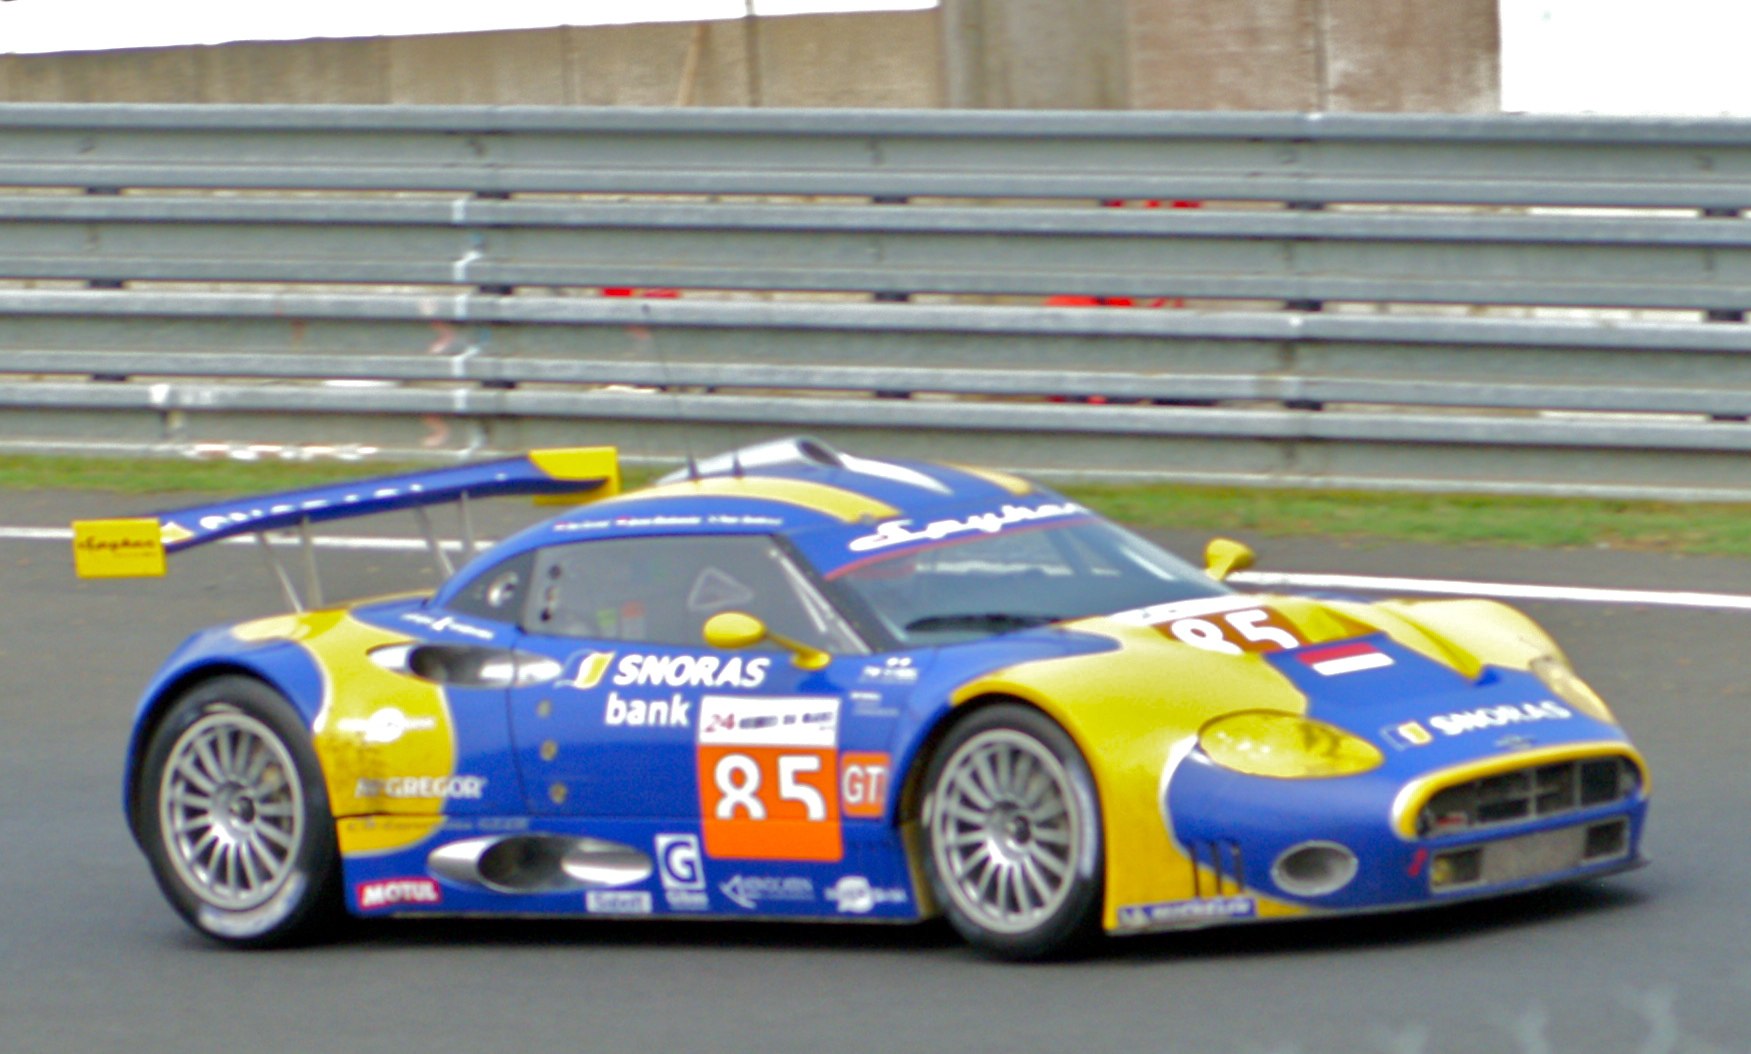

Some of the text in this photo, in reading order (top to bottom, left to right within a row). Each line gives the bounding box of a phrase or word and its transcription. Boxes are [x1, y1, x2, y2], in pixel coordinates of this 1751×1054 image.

[1170, 608, 1299, 655] 85
[613, 654, 771, 677] SNORAS
[605, 691, 690, 726] bank
[715, 753, 827, 821] 85
[362, 881, 437, 907] MOTUL
